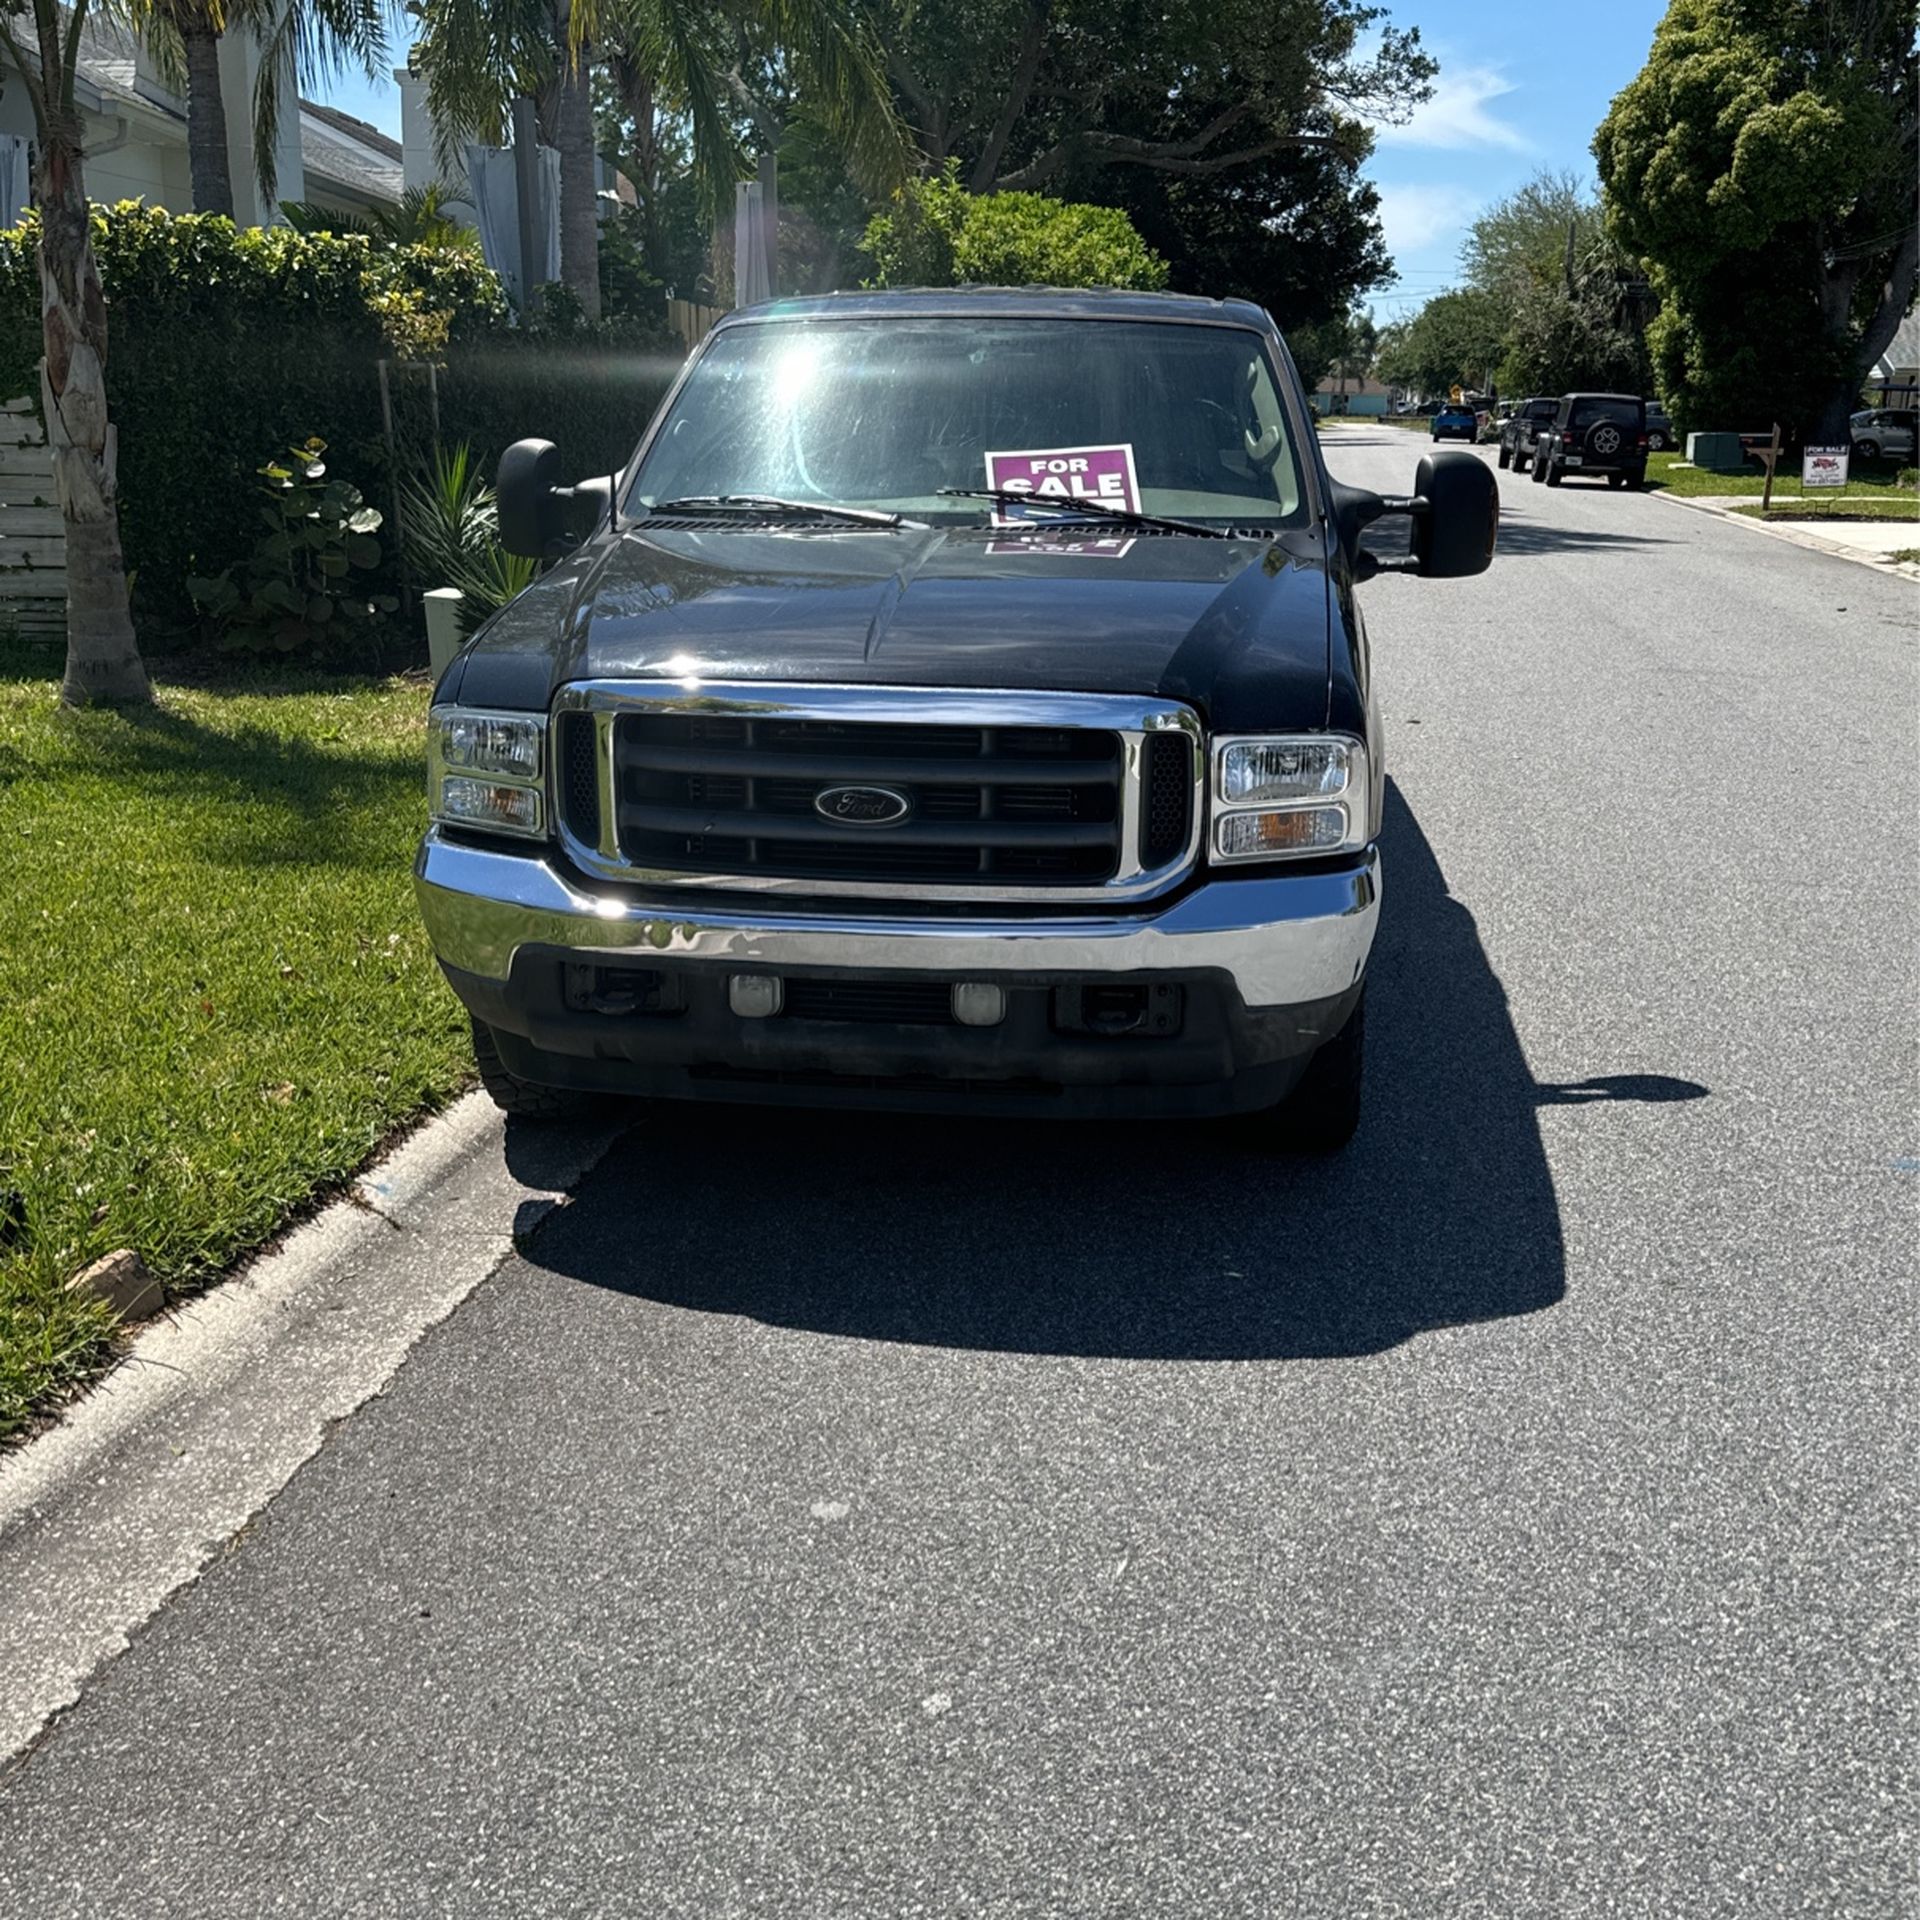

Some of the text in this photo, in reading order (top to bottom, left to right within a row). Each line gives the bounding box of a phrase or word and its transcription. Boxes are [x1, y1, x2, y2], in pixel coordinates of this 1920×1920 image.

[1030, 458, 1088, 474] FOR
[1002, 473, 1124, 498] SALE
[836, 793, 886, 815] Ford
